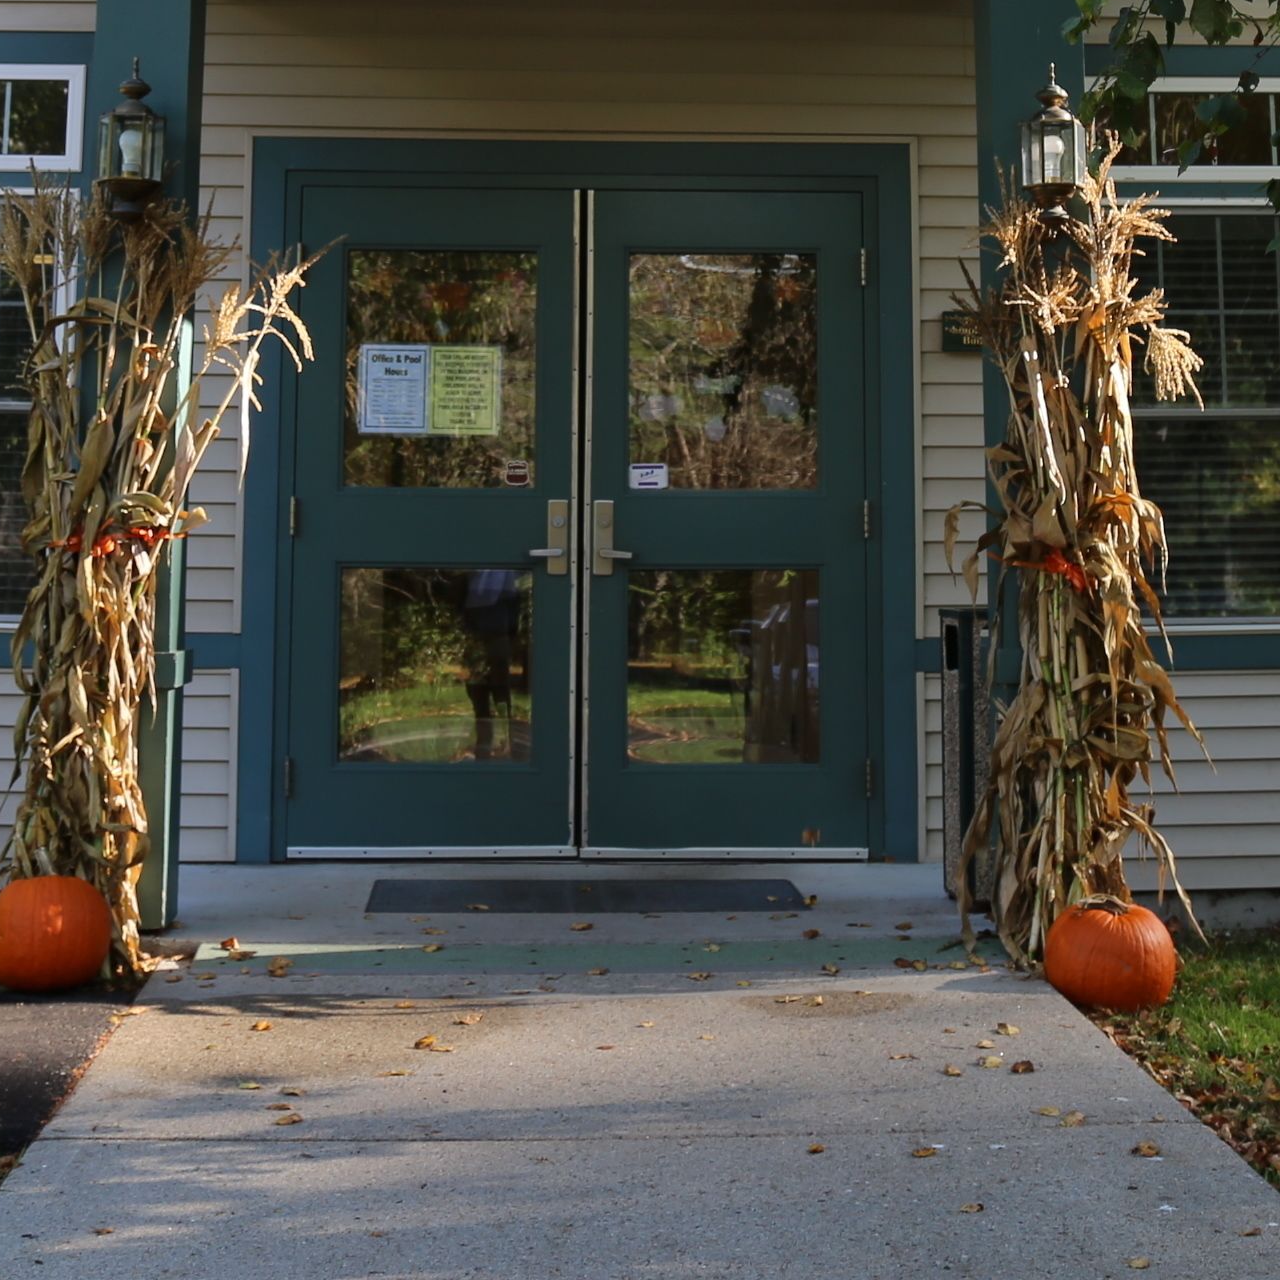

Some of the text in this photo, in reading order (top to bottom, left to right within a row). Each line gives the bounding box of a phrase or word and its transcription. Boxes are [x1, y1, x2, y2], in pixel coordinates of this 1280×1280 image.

[371, 353, 422, 364] Office & Pool
[384, 367, 408, 376] Hours
